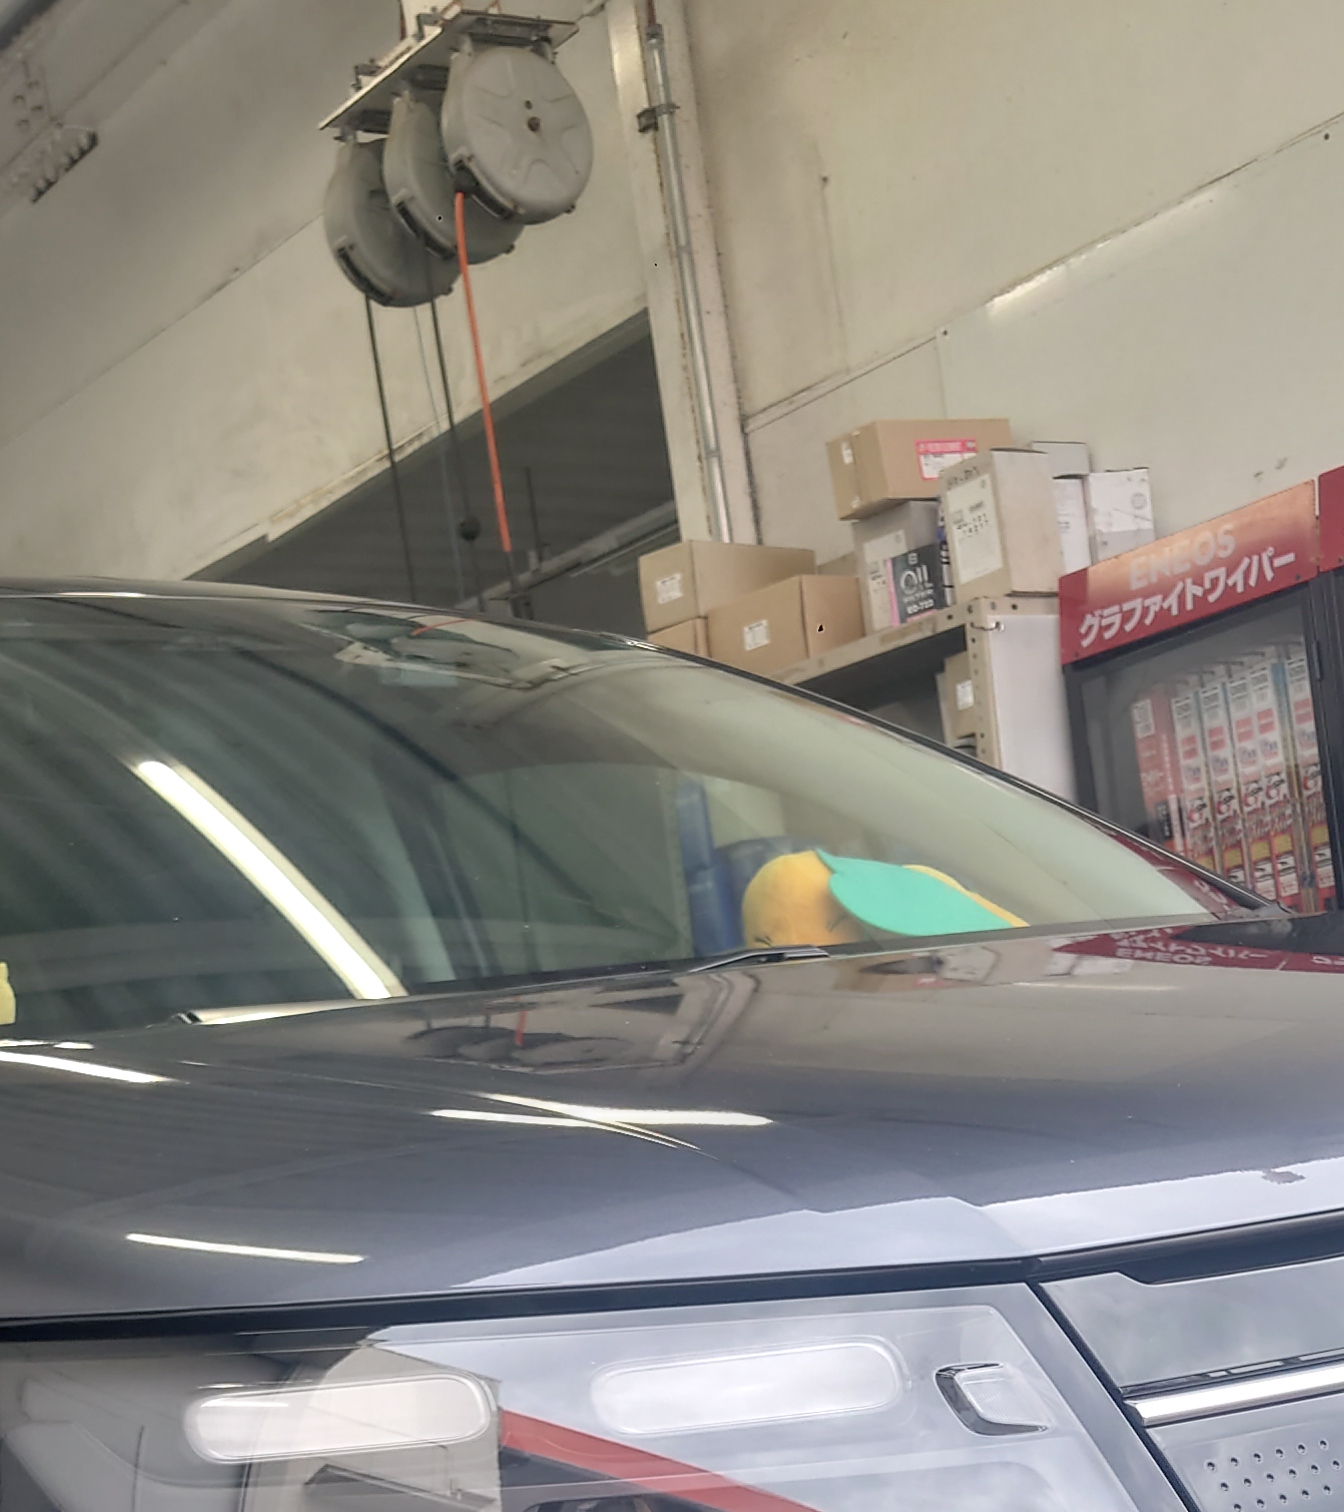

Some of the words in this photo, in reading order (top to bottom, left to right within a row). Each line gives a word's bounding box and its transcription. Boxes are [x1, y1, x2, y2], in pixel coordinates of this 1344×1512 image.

[1079, 547, 1296, 648] グラファイトワイパー
[1128, 524, 1237, 590] ENEOS
